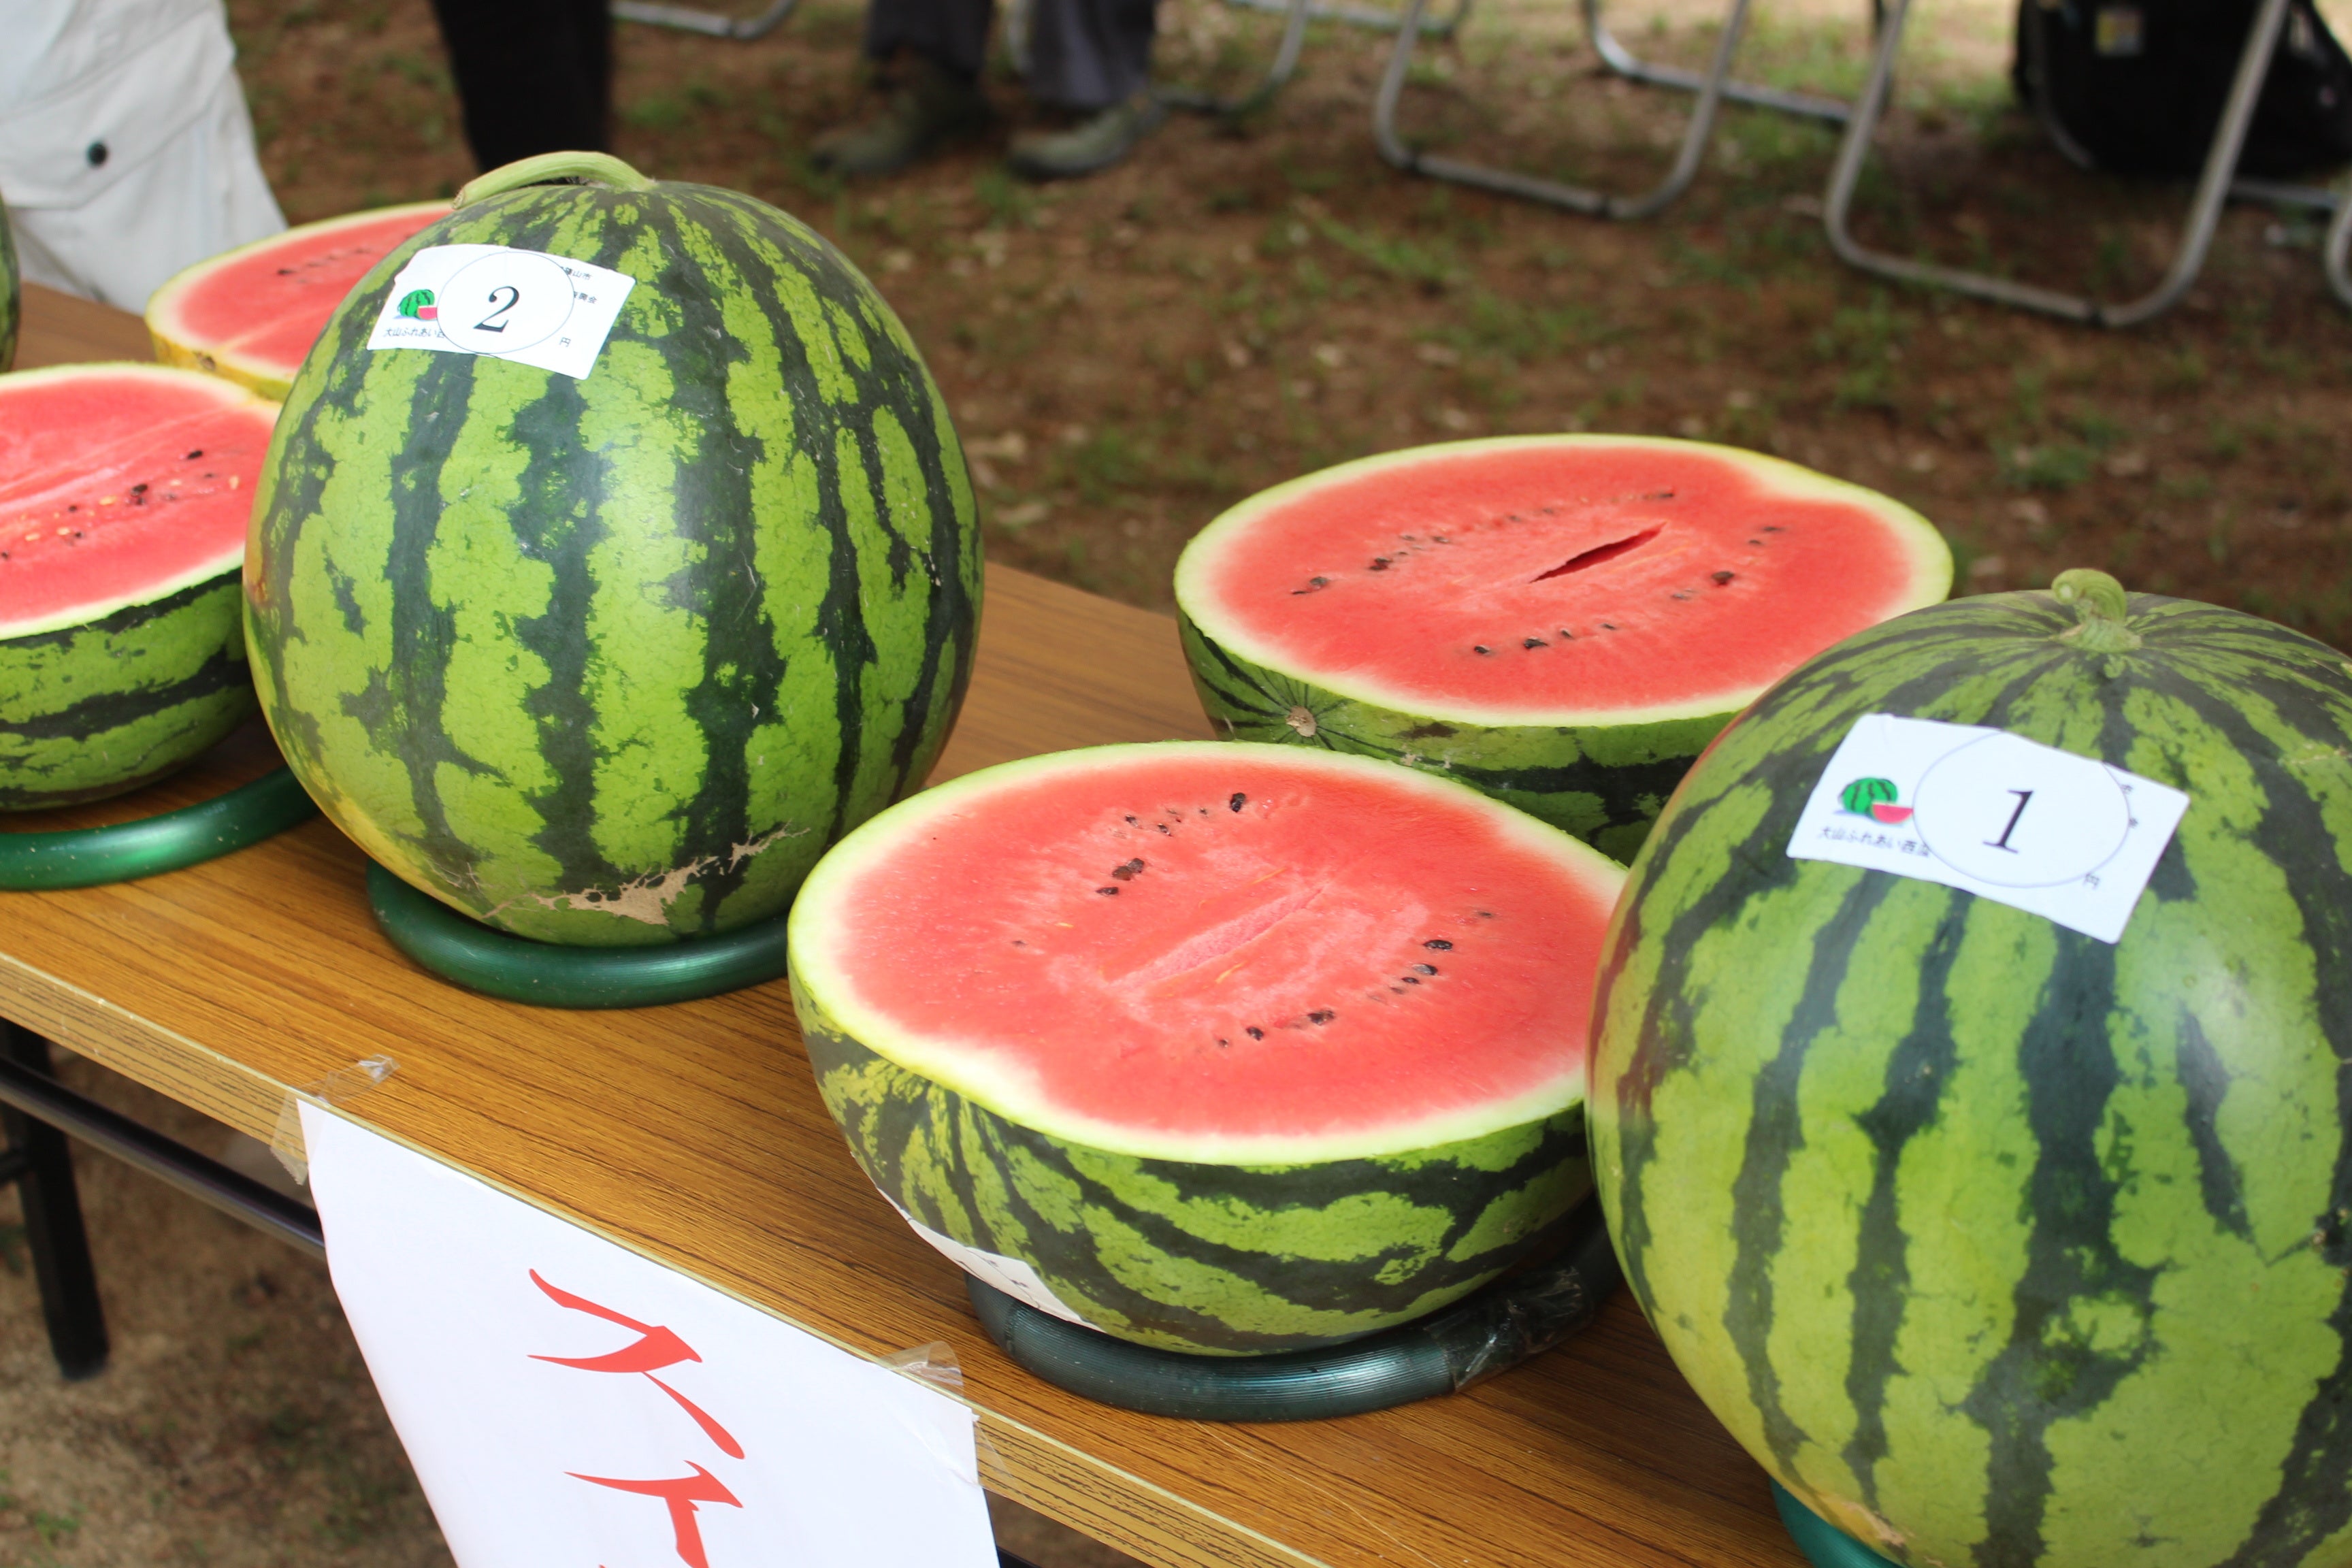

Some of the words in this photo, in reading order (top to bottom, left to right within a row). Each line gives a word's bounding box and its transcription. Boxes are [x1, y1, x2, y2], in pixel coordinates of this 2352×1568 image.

[473, 285, 520, 333] 2
[559, 336, 572, 349] 円
[1982, 789, 2035, 854] 1
[526, 1267, 745, 1568] スイ
